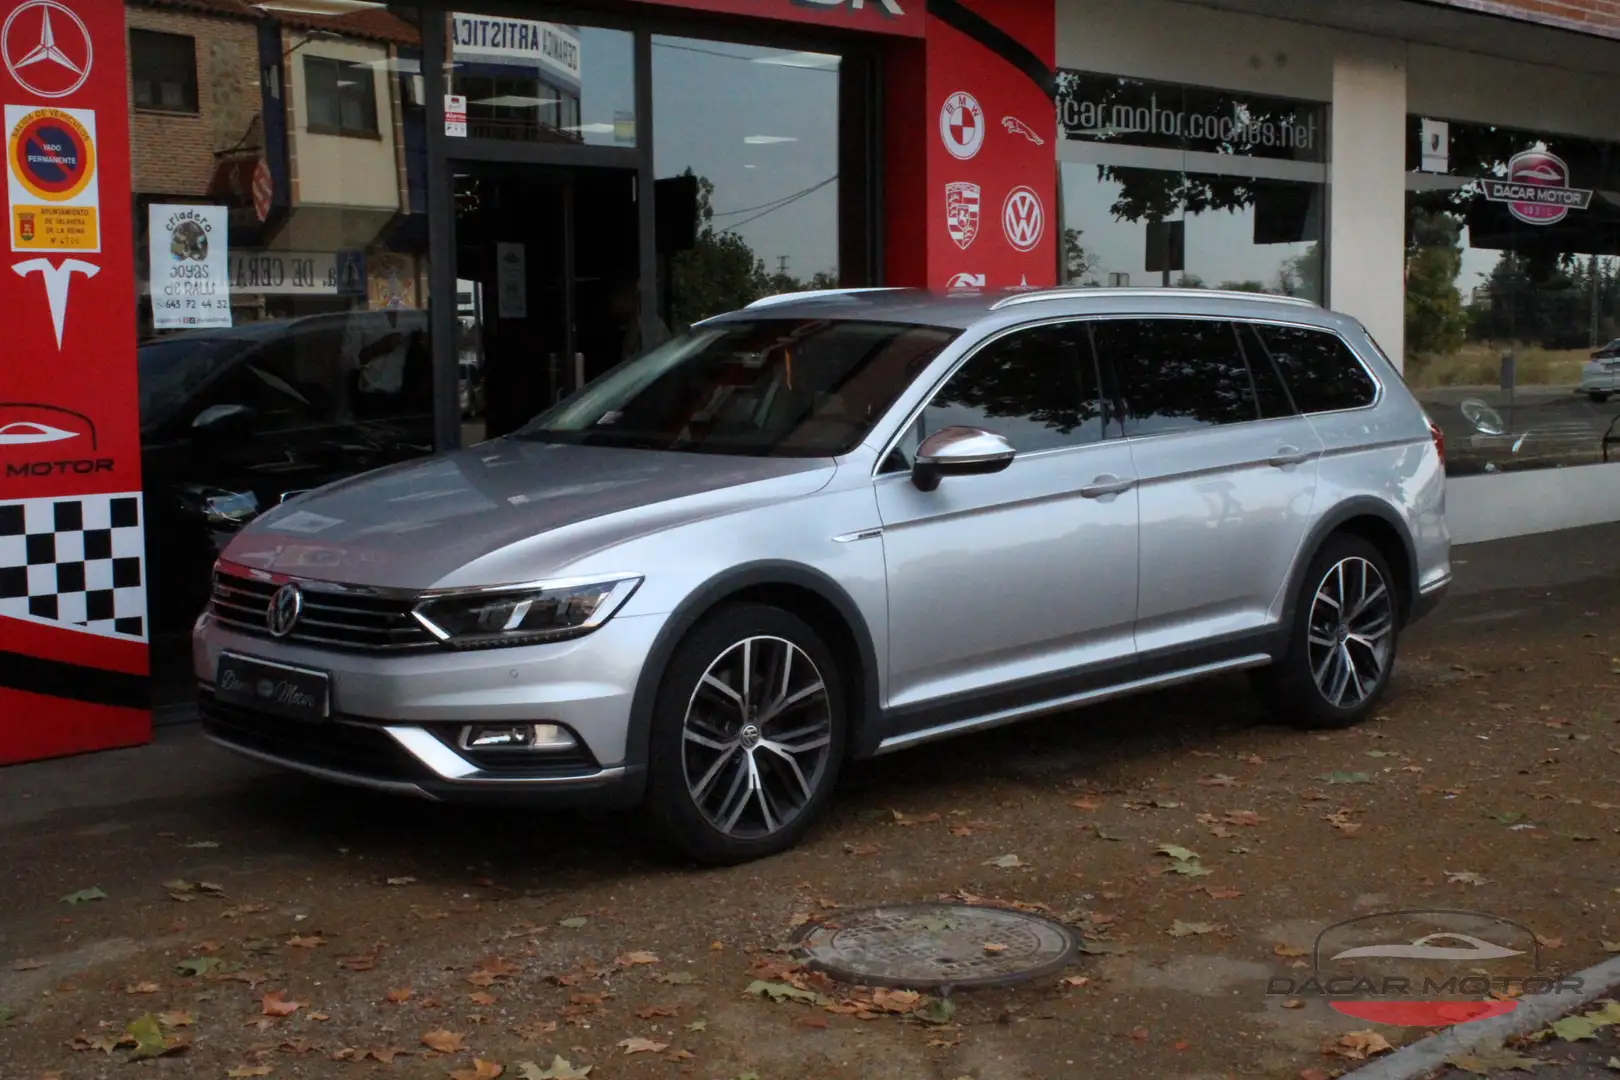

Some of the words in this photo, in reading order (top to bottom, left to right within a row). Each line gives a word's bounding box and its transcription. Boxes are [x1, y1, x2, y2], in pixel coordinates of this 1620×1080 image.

[946, 96, 981, 117] BMW
[11, 113, 34, 138] SALIDA
[49, 109, 90, 141] VEHICULOS
[28, 155, 76, 165] PERMANENTE
[1493, 184, 1535, 201] DACAR
[1537, 190, 1581, 205] MOTOR
[41, 208, 89, 216] AYUNTAMIENTO
[165, 209, 212, 233] criadero
[164, 281, 181, 296] de
[165, 299, 181, 308] 643
[185, 299, 196, 308] 72
[201, 299, 212, 308] 44
[216, 300, 228, 308] 32
[5, 458, 115, 477] MOTOR
